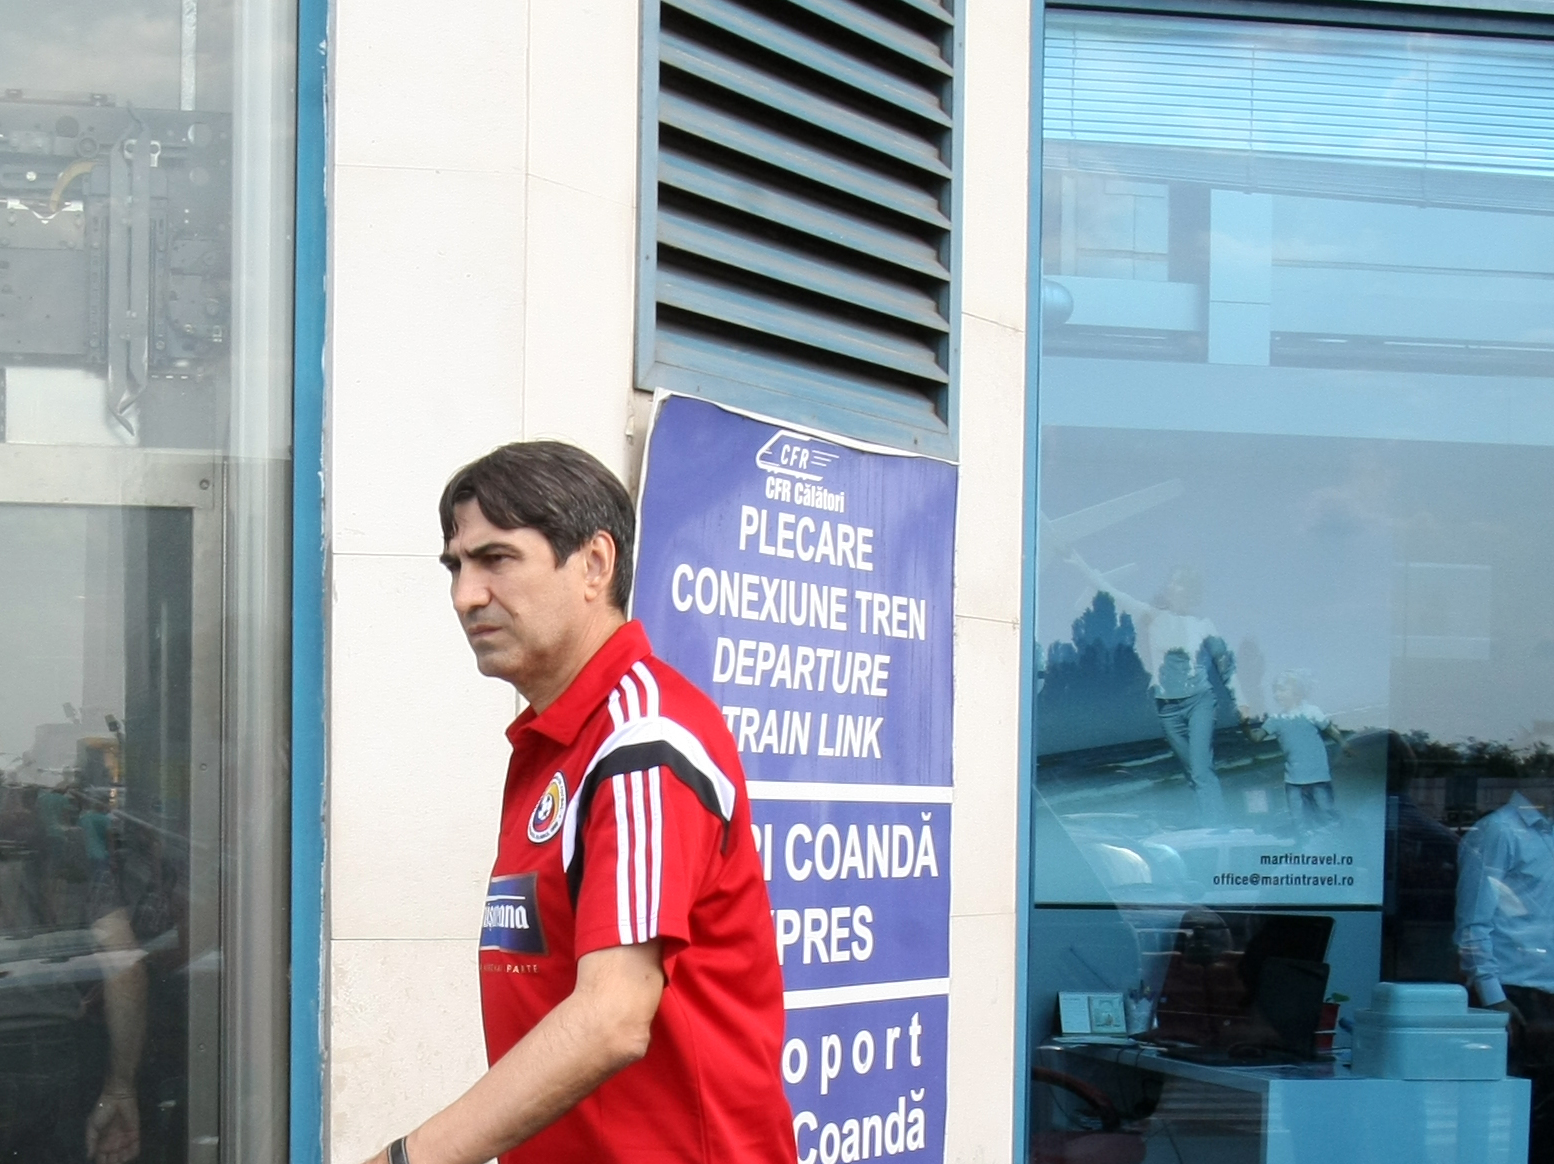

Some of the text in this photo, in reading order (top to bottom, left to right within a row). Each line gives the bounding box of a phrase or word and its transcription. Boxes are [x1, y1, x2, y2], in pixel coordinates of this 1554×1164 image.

[780, 444, 809, 469] CFR
[765, 475, 845, 513] CFR Călători
[739, 504, 874, 571] PLECARE
[671, 563, 926, 640] CONEXIUNE TREN
[712, 637, 891, 697] DEPARTURE
[722, 705, 884, 758] TRAIN LINK
[784, 811, 939, 881] COANDĂ
[1260, 853, 1353, 865] martintravel.ro
[1213, 873, 1354, 886] office@martintravel.ro
[770, 905, 874, 966] PRES
